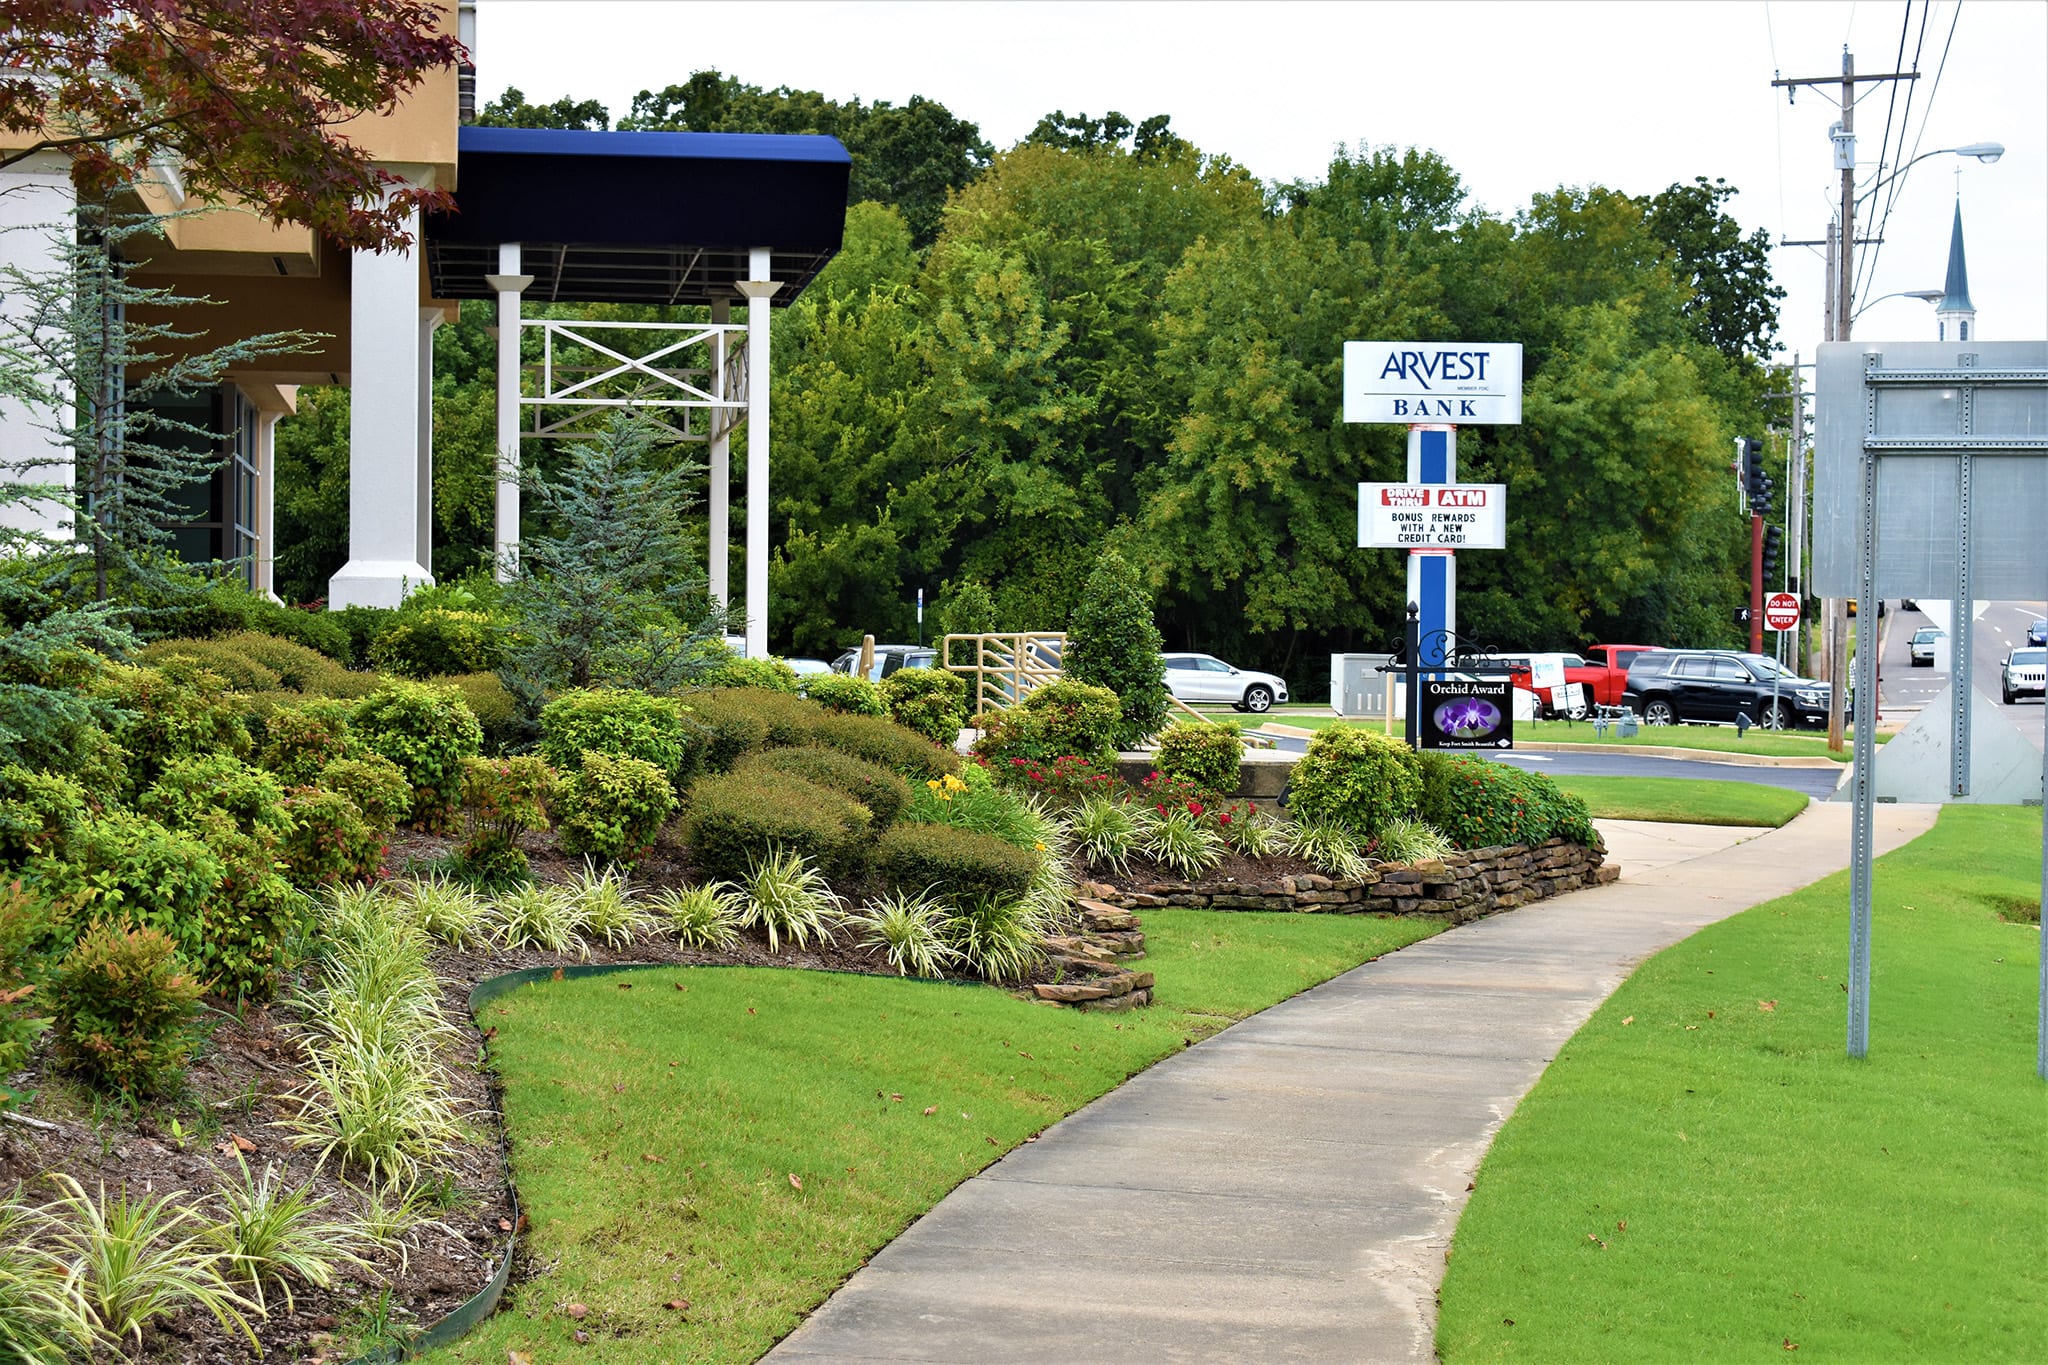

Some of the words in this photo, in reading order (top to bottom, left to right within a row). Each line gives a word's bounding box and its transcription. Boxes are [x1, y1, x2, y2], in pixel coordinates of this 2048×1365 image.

[1380, 352, 1490, 390] ARVEST
[1393, 400, 1476, 416] BANK
[1387, 488, 1424, 498] DRIVE
[1440, 490, 1484, 506] ATM
[1388, 498, 1423, 506] THRU
[1392, 512, 1423, 522] BONUS
[1432, 513, 1476, 523] REWARDS
[1400, 524, 1424, 532] WITH
[1430, 524, 1436, 532] A
[1444, 524, 1462, 532] NEW
[1398, 534, 1431, 542] CREDIT
[1438, 534, 1466, 543] CARD!
[1430, 684, 1468, 694] Orchid
[1471, 684, 1505, 694] Award
